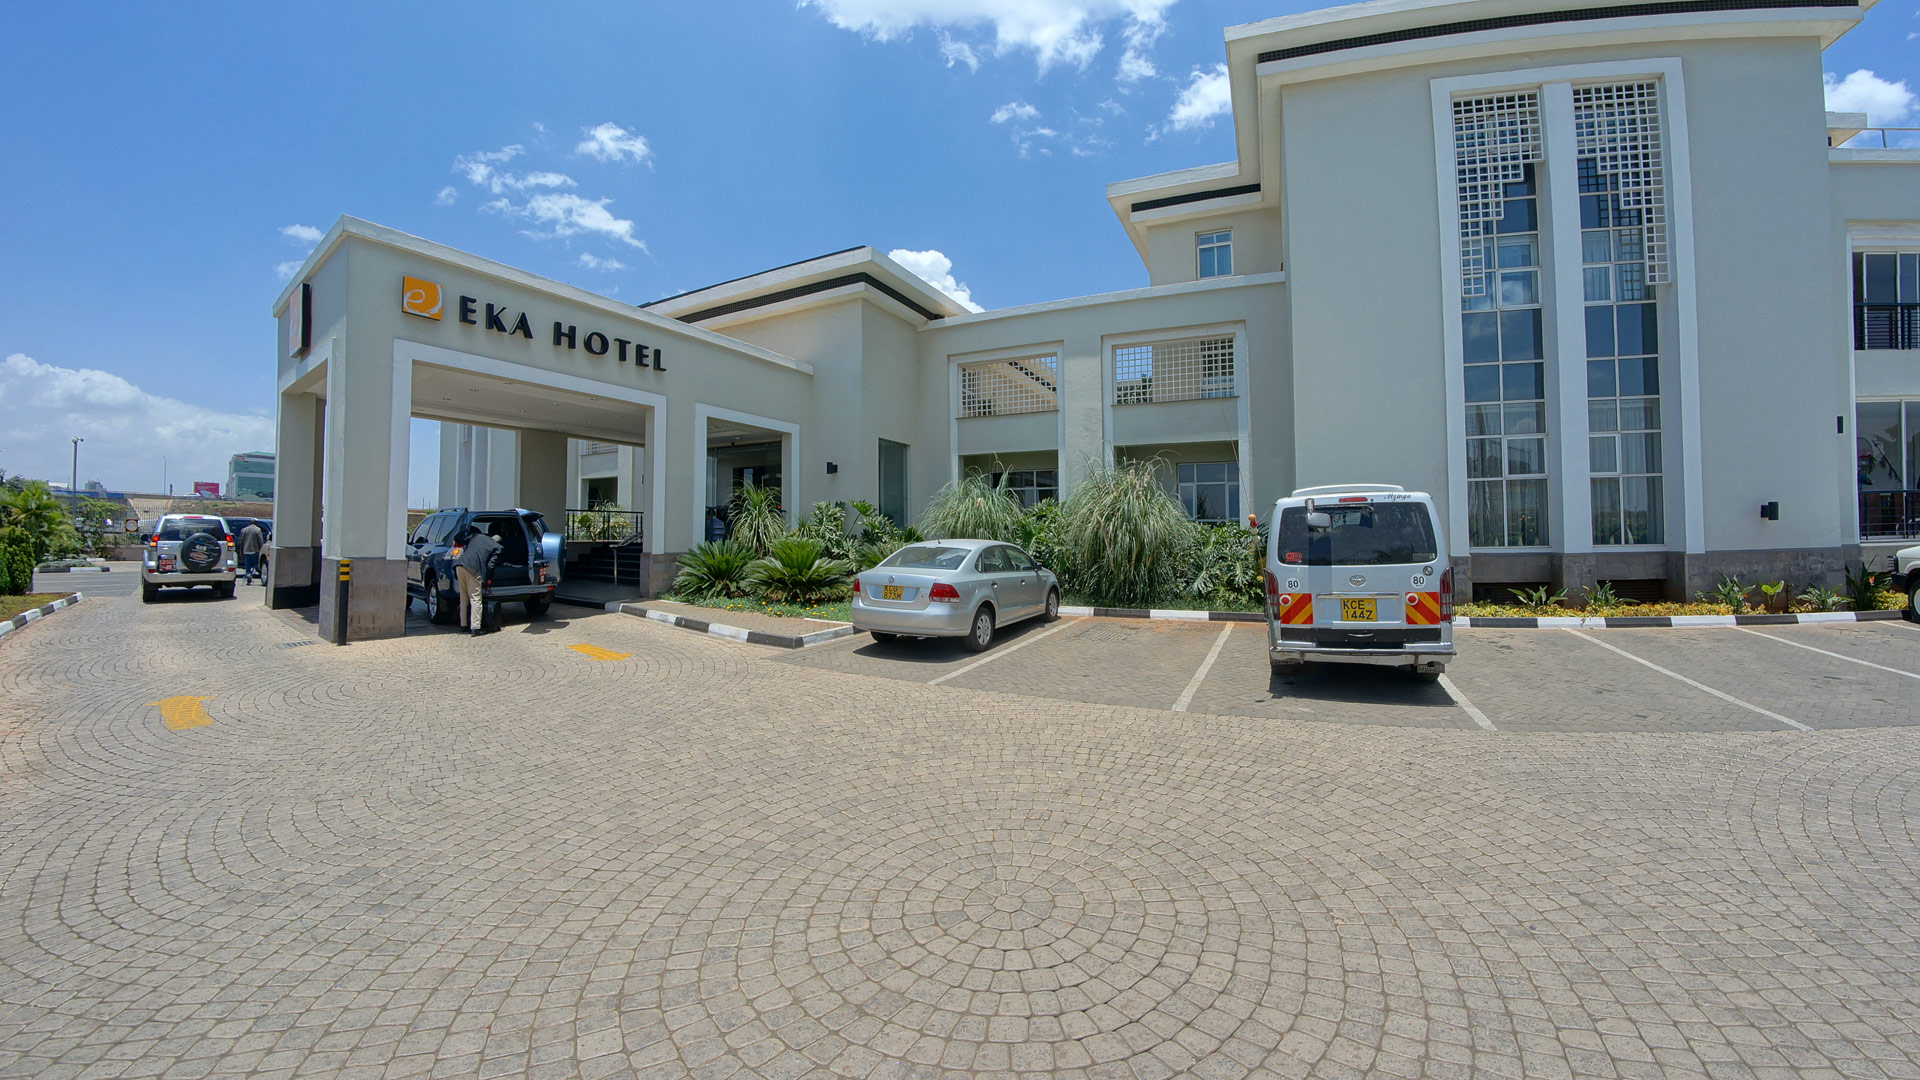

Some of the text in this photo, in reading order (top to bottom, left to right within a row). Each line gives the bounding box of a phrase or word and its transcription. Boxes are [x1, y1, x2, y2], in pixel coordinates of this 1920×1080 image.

[459, 295, 667, 372] EKA HOTEL
[1287, 580, 1299, 588] 80
[1413, 576, 1424, 584] 80
[1343, 600, 1365, 610] KCE
[1345, 610, 1373, 620] 144Z
